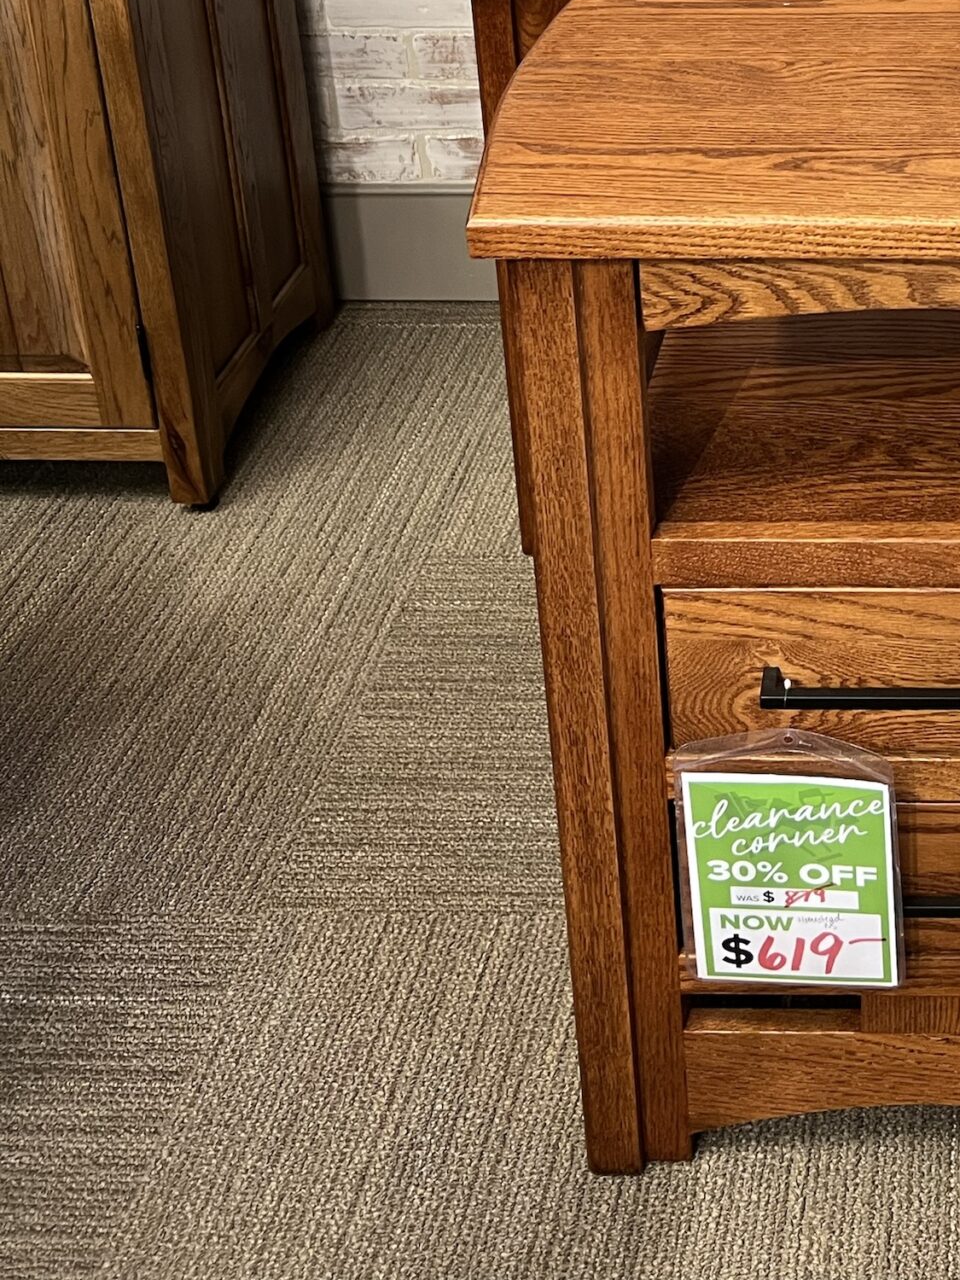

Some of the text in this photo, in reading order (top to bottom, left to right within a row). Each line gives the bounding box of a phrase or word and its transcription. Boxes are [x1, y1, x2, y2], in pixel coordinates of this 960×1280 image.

[692, 799, 887, 839] clearance
[731, 823, 868, 856] corner
[706, 860, 878, 887] 30% OFF
[736, 894, 760, 902] WAS
[720, 914, 794, 931] NOW
